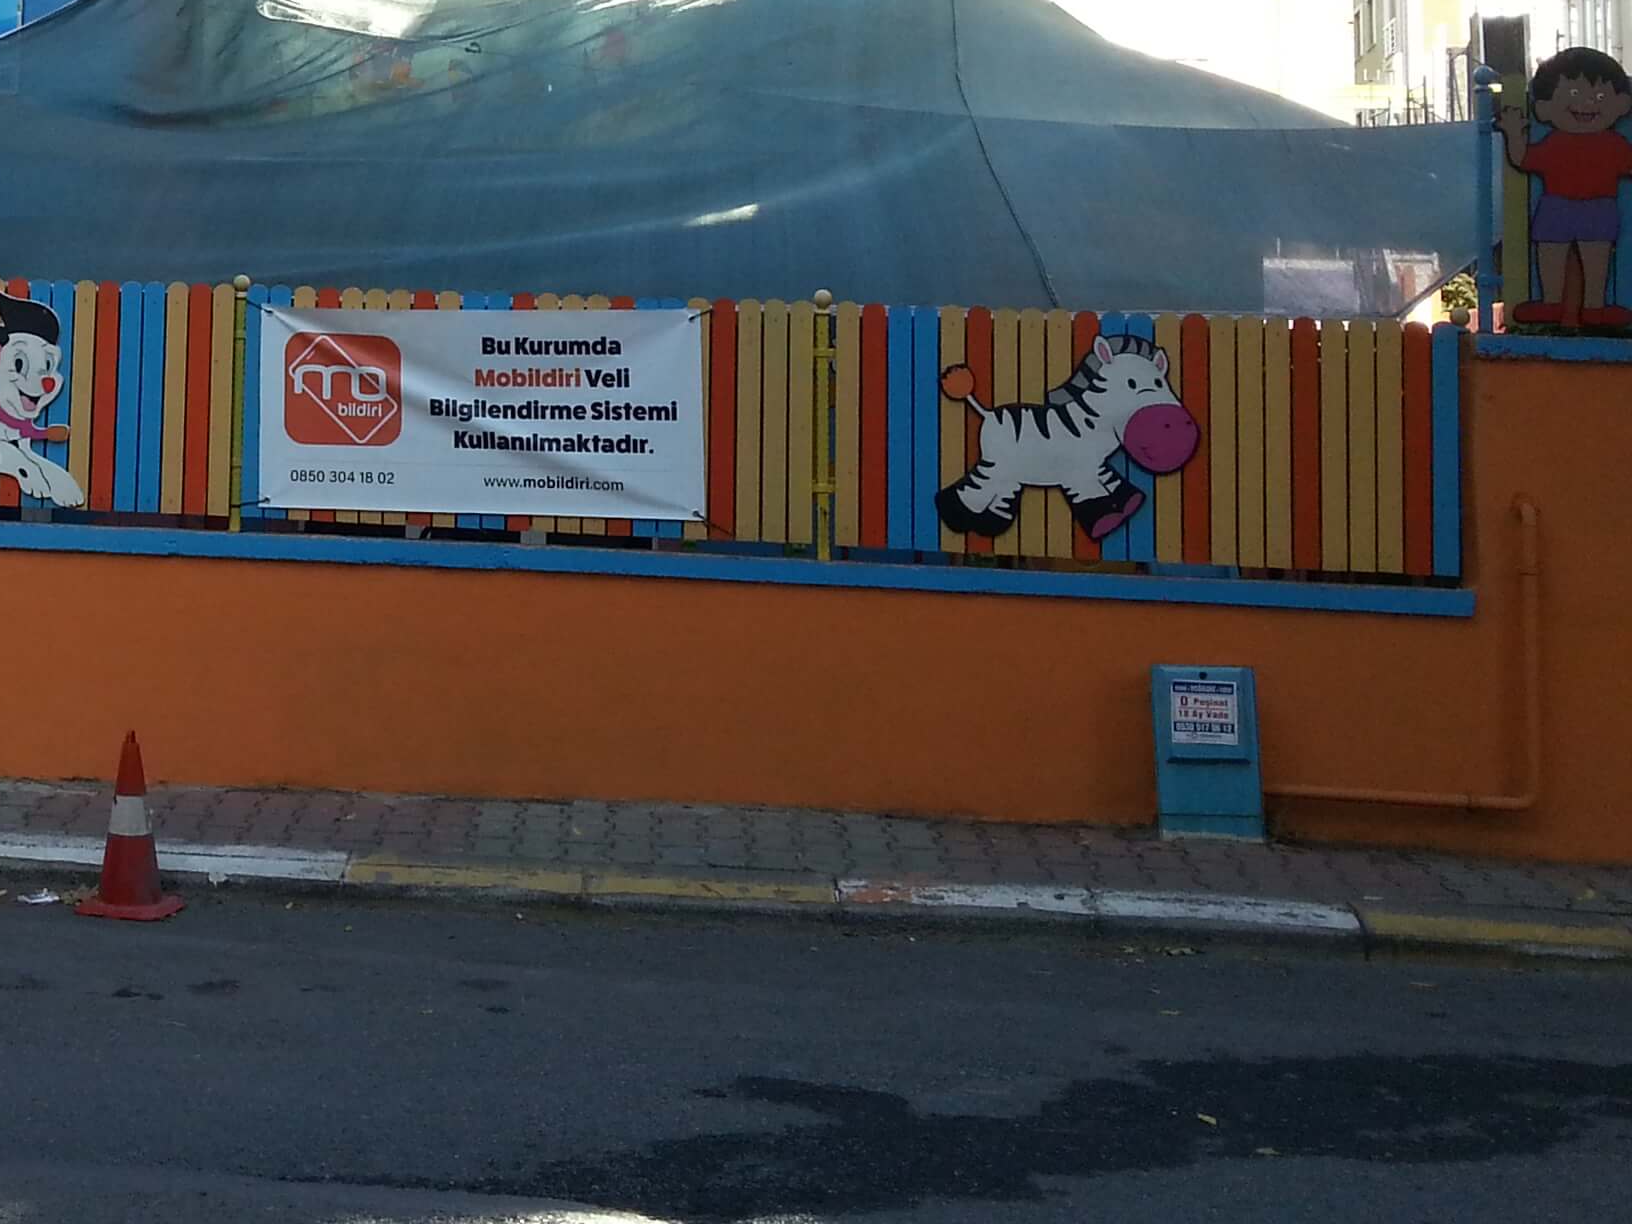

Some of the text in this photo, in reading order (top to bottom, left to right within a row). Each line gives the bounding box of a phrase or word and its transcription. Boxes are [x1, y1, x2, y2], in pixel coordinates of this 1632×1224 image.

[481, 336, 622, 357] Bu Kurumda
[474, 368, 630, 388] Mobildiri Veli
[337, 401, 384, 418] bildiri
[429, 398, 678, 422] Bilgilendirme Sistemi
[453, 429, 655, 455] Kullanılmaktadır.
[290, 470, 395, 484] 0850 304 18 02
[483, 474, 625, 492] www.mobildiri.com
